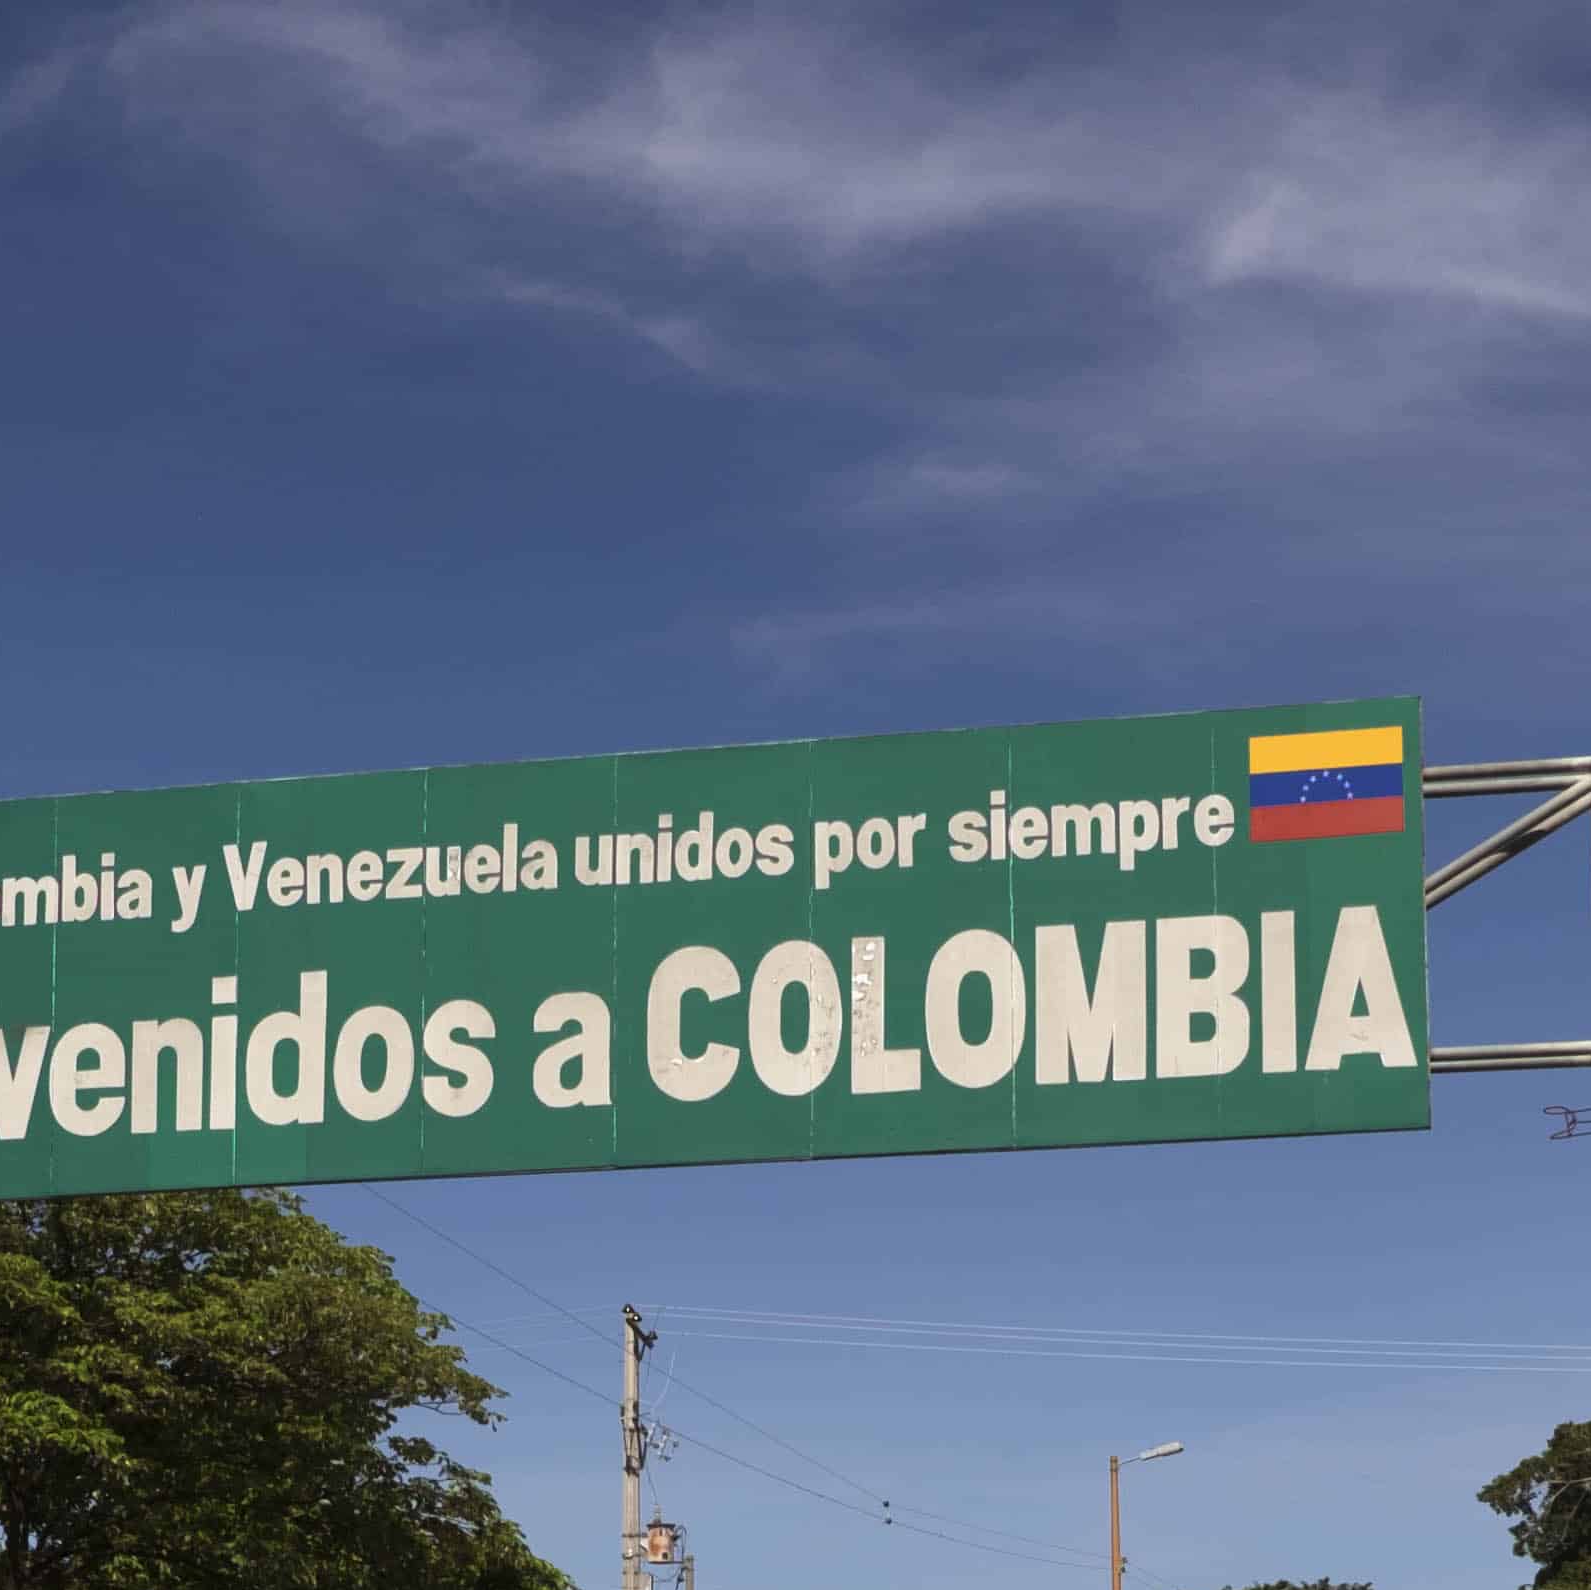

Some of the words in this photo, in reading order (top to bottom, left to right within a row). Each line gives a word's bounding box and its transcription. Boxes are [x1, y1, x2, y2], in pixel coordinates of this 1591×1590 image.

[170, 864, 208, 933] y
[222, 822, 559, 912] Venezuela
[574, 810, 795, 886] unidos
[814, 814, 927, 890] por
[948, 790, 1235, 872] siempre
[532, 992, 613, 1108] a
[646, 904, 1419, 1102] COLOMBIA
